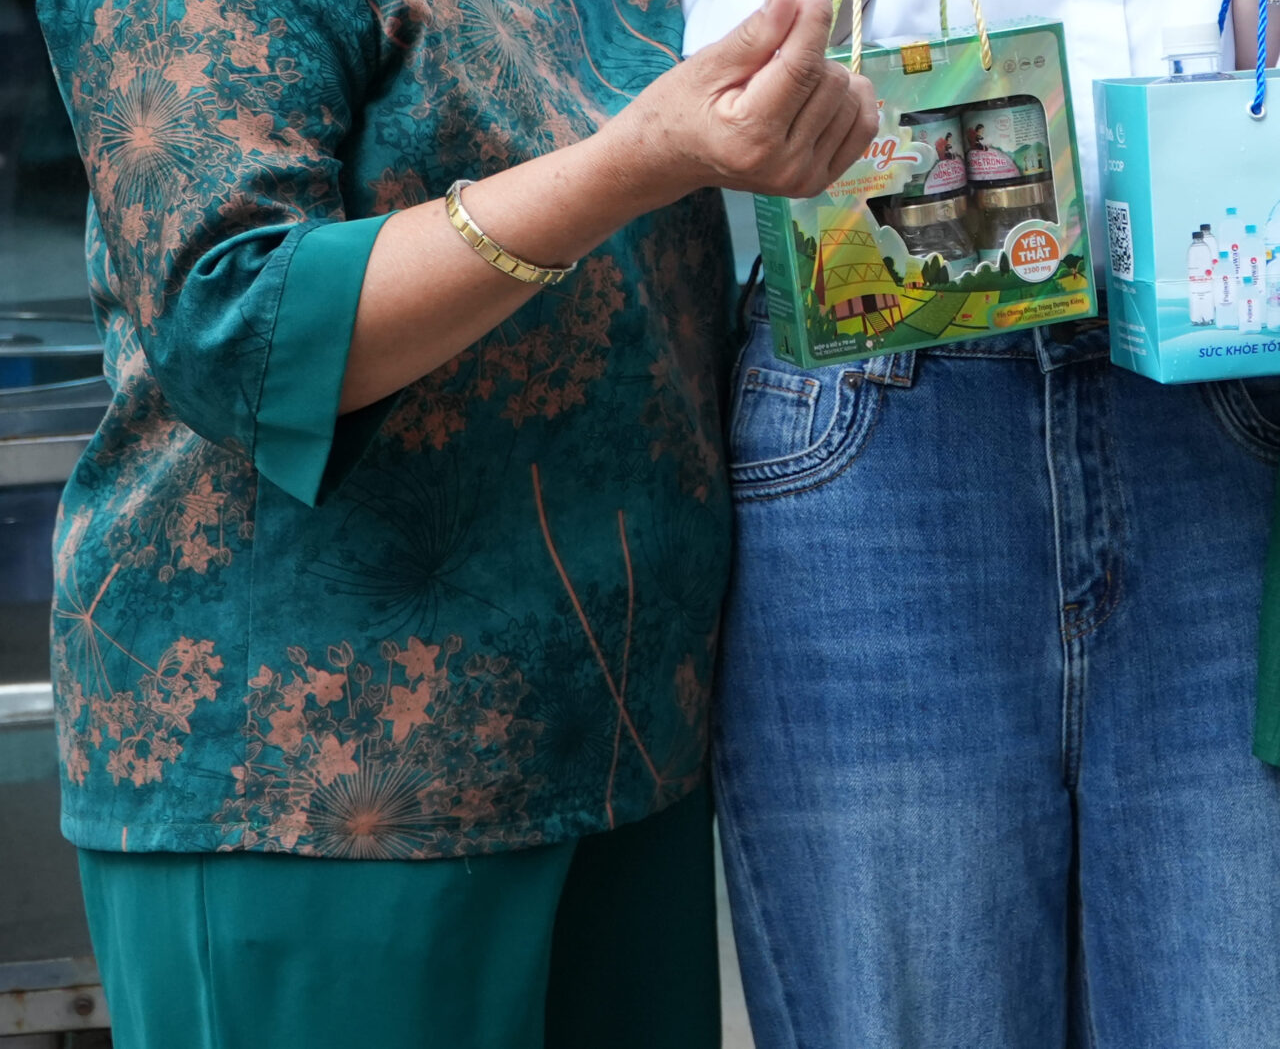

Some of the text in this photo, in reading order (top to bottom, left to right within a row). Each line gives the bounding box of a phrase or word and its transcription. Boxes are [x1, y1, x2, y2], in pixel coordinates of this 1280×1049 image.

[1021, 233, 1046, 249] YẾN
[1018, 247, 1052, 262] THẬT
[1041, 265, 1052, 273] mg
[1199, 345, 1223, 358] SỨC
